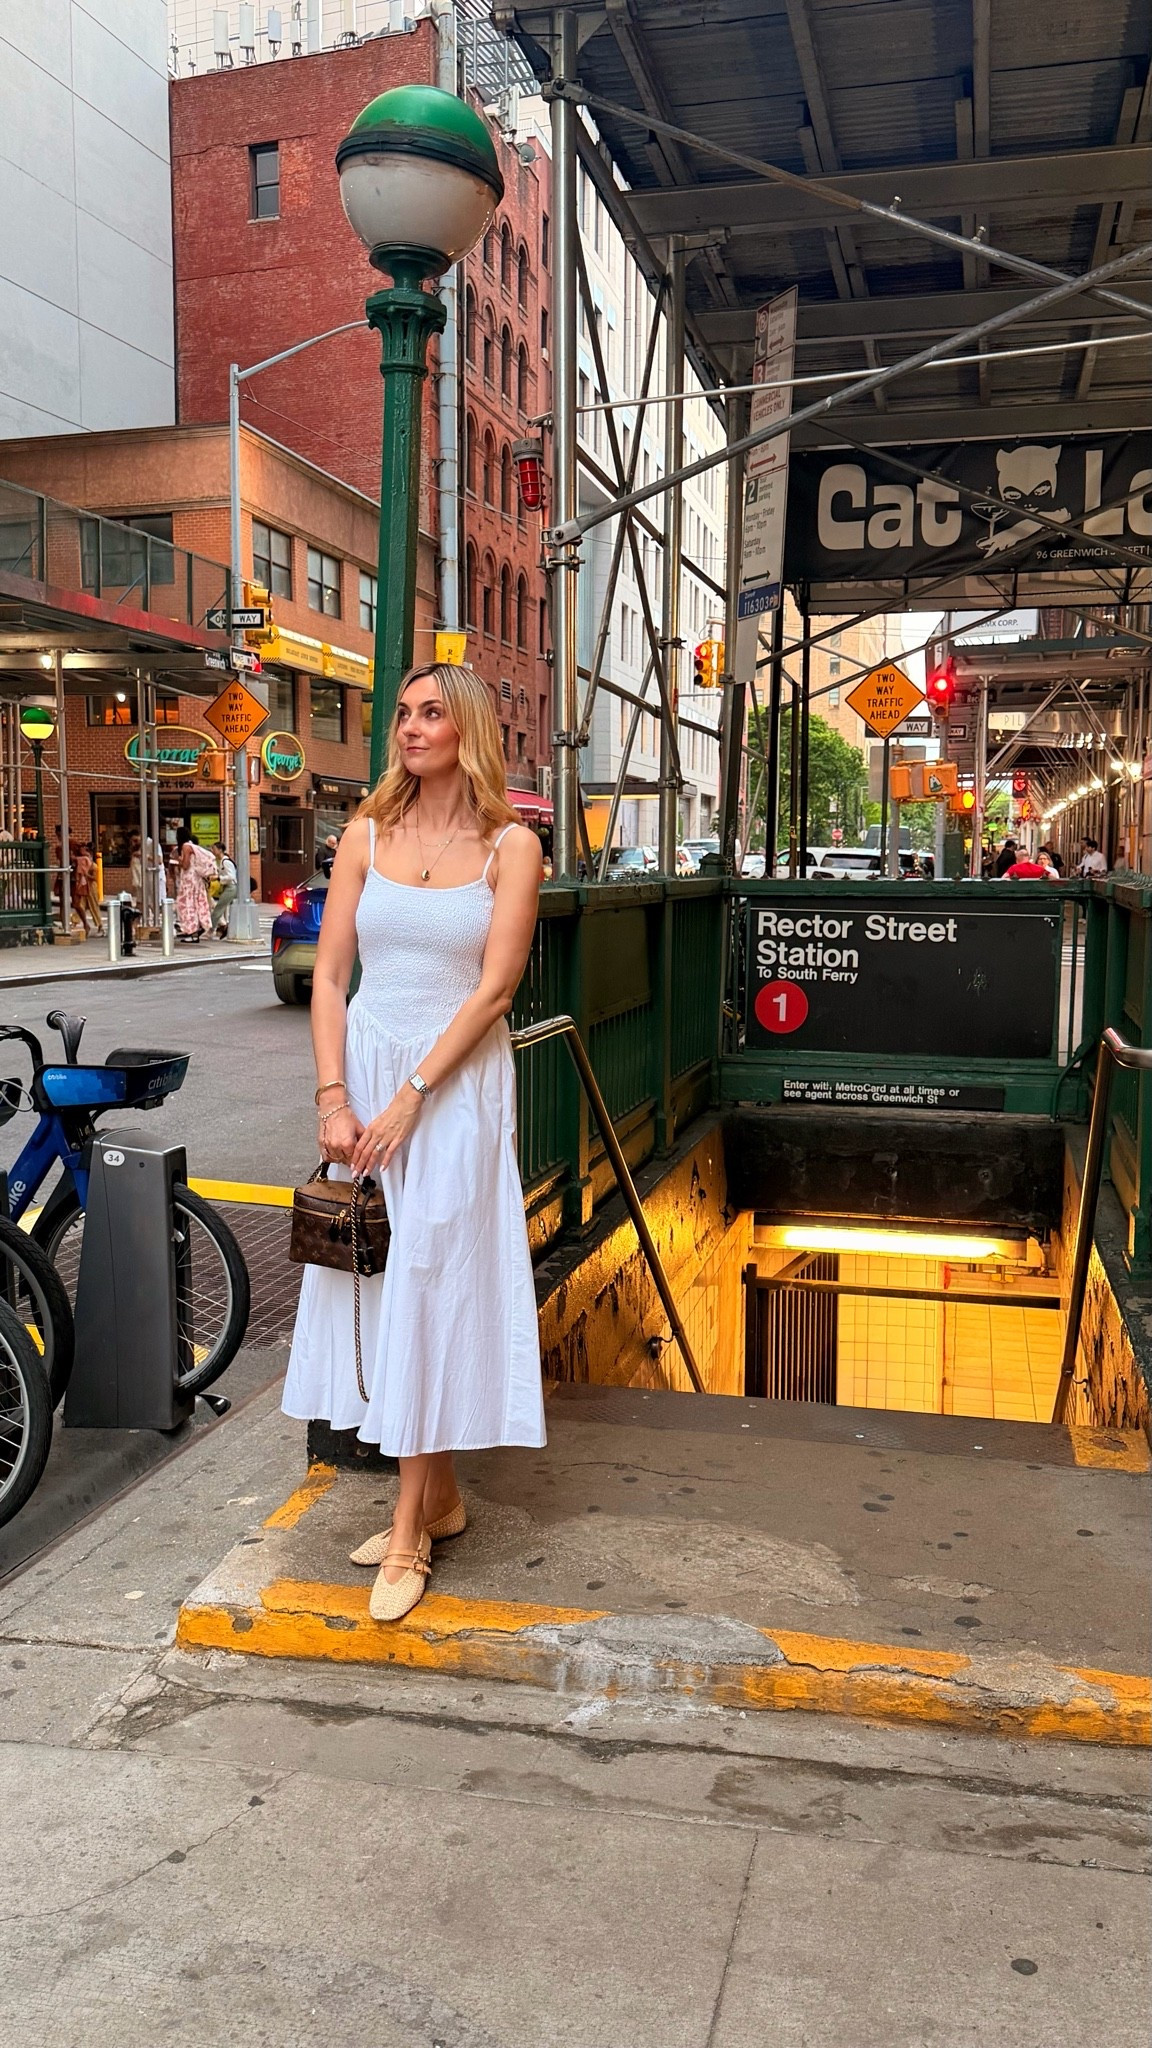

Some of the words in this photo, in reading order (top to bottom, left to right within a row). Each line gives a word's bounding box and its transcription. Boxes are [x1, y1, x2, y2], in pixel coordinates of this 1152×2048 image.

[757, 364, 764, 384] 3
[754, 389, 781, 410] COMMERCIAL
[753, 405, 773, 421] VEHICLES
[773, 399, 785, 413] ONLY
[747, 480, 756, 503] 2
[817, 463, 963, 551] Cat
[745, 513, 760, 522] Monday
[763, 507, 775, 518] Friday
[744, 538, 761, 549] Saturday
[1036, 551, 1048, 559] 96
[1050, 547, 1108, 559] GREENWICH
[744, 596, 770, 615] 116303
[240, 615, 257, 623] WAY
[998, 619, 1019, 627] CORP.
[876, 673, 895, 683] TWO
[875, 685, 894, 696] WAY
[228, 692, 244, 701] TWO
[228, 703, 243, 712] WAY
[867, 697, 904, 708] TRAFFIC
[221, 713, 252, 723] TRAFFIC
[869, 709, 900, 720] AHEAD
[224, 724, 250, 733] AHEAD
[906, 722, 925, 732] WAY
[948, 728, 962, 736] WAY
[265, 738, 304, 776] George's
[175, 781, 195, 789] 1950
[757, 911, 853, 939] Rector
[865, 914, 958, 943] Street
[756, 939, 859, 968] Station
[756, 966, 772, 979] To
[777, 966, 818, 981] South
[822, 968, 858, 984] Ferry
[772, 993, 787, 1022] 1
[783, 1080, 809, 1090] Enter
[835, 1082, 887, 1093] MetroCard
[889, 1085, 900, 1094] at
[903, 1085, 915, 1094] all
[918, 1086, 945, 1096] times
[949, 1089, 960, 1097] or
[783, 1090, 802, 1098] see
[805, 1090, 832, 1100] agent
[835, 1093, 869, 1101] across
[871, 1092, 924, 1104] Greenwich
[926, 1095, 939, 1104] St
[107, 1154, 120, 1163] 34
